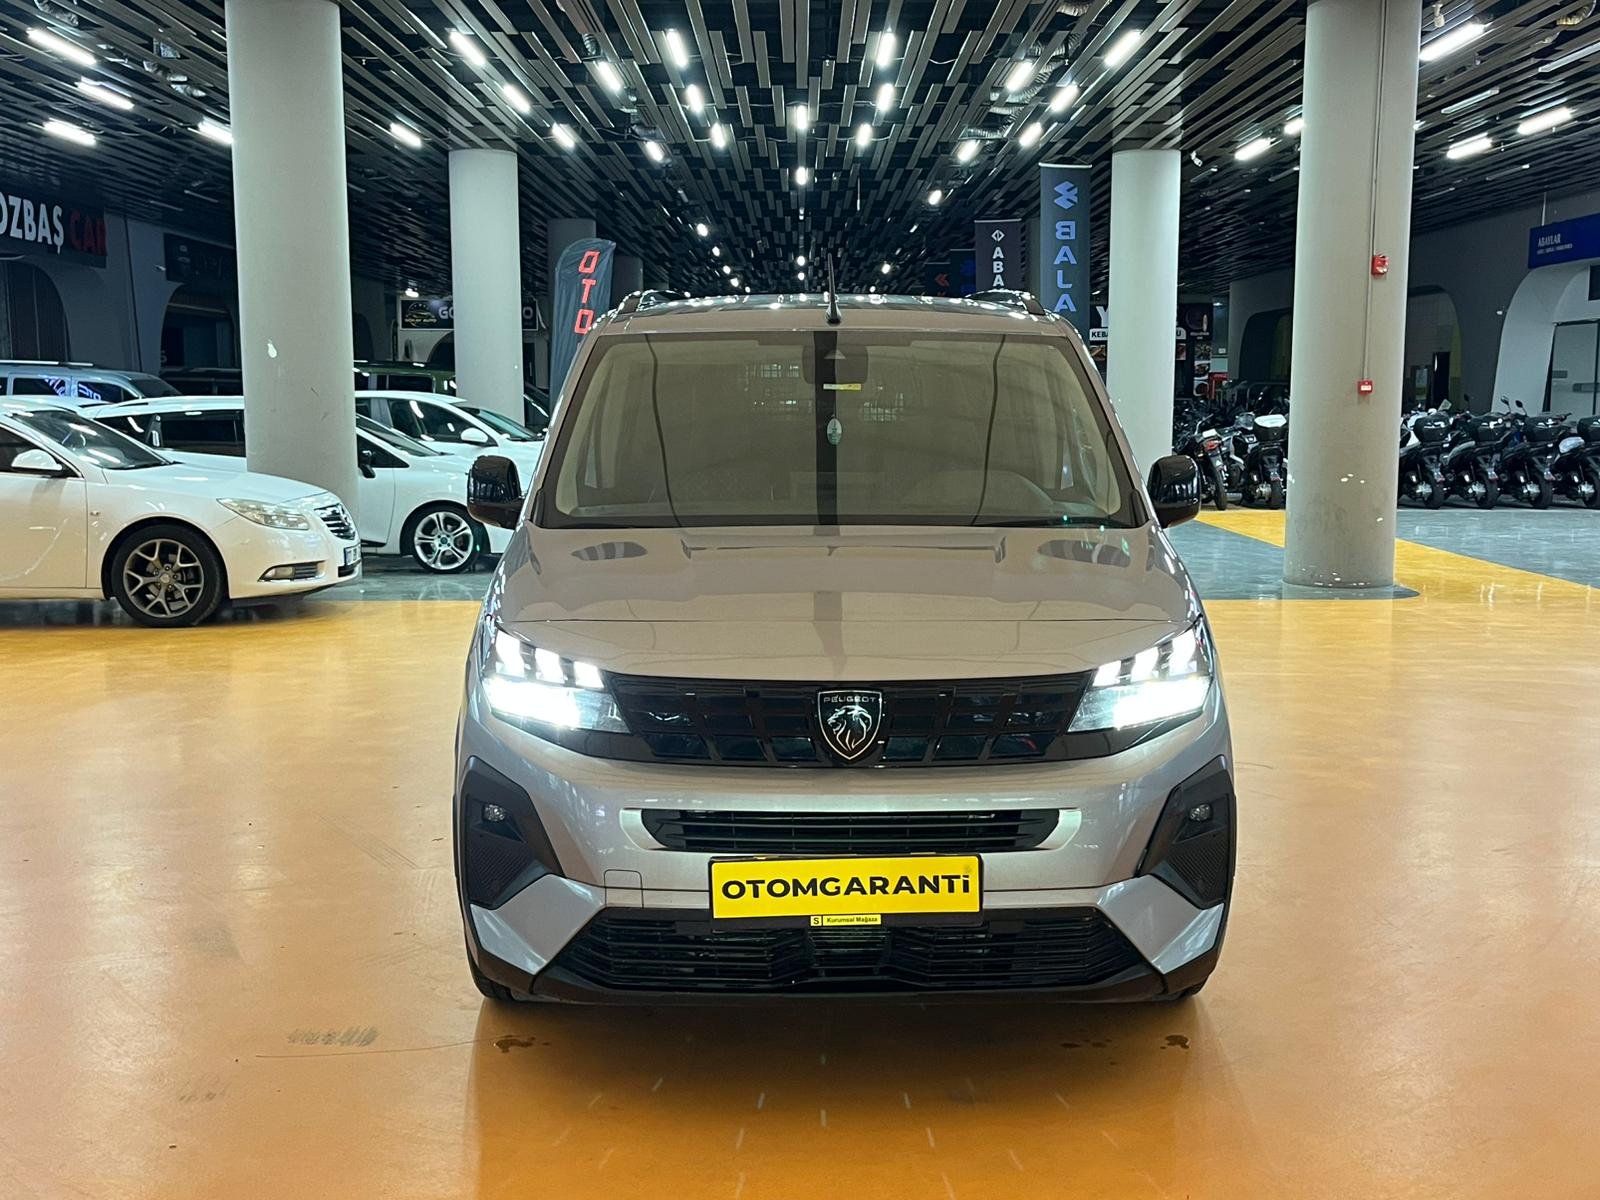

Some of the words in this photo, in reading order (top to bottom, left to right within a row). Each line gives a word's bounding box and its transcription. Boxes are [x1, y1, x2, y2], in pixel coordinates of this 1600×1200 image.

[992, 247, 1004, 287] ABA
[574, 250, 600, 335] OTO
[823, 695, 876, 703] PEUGEOT
